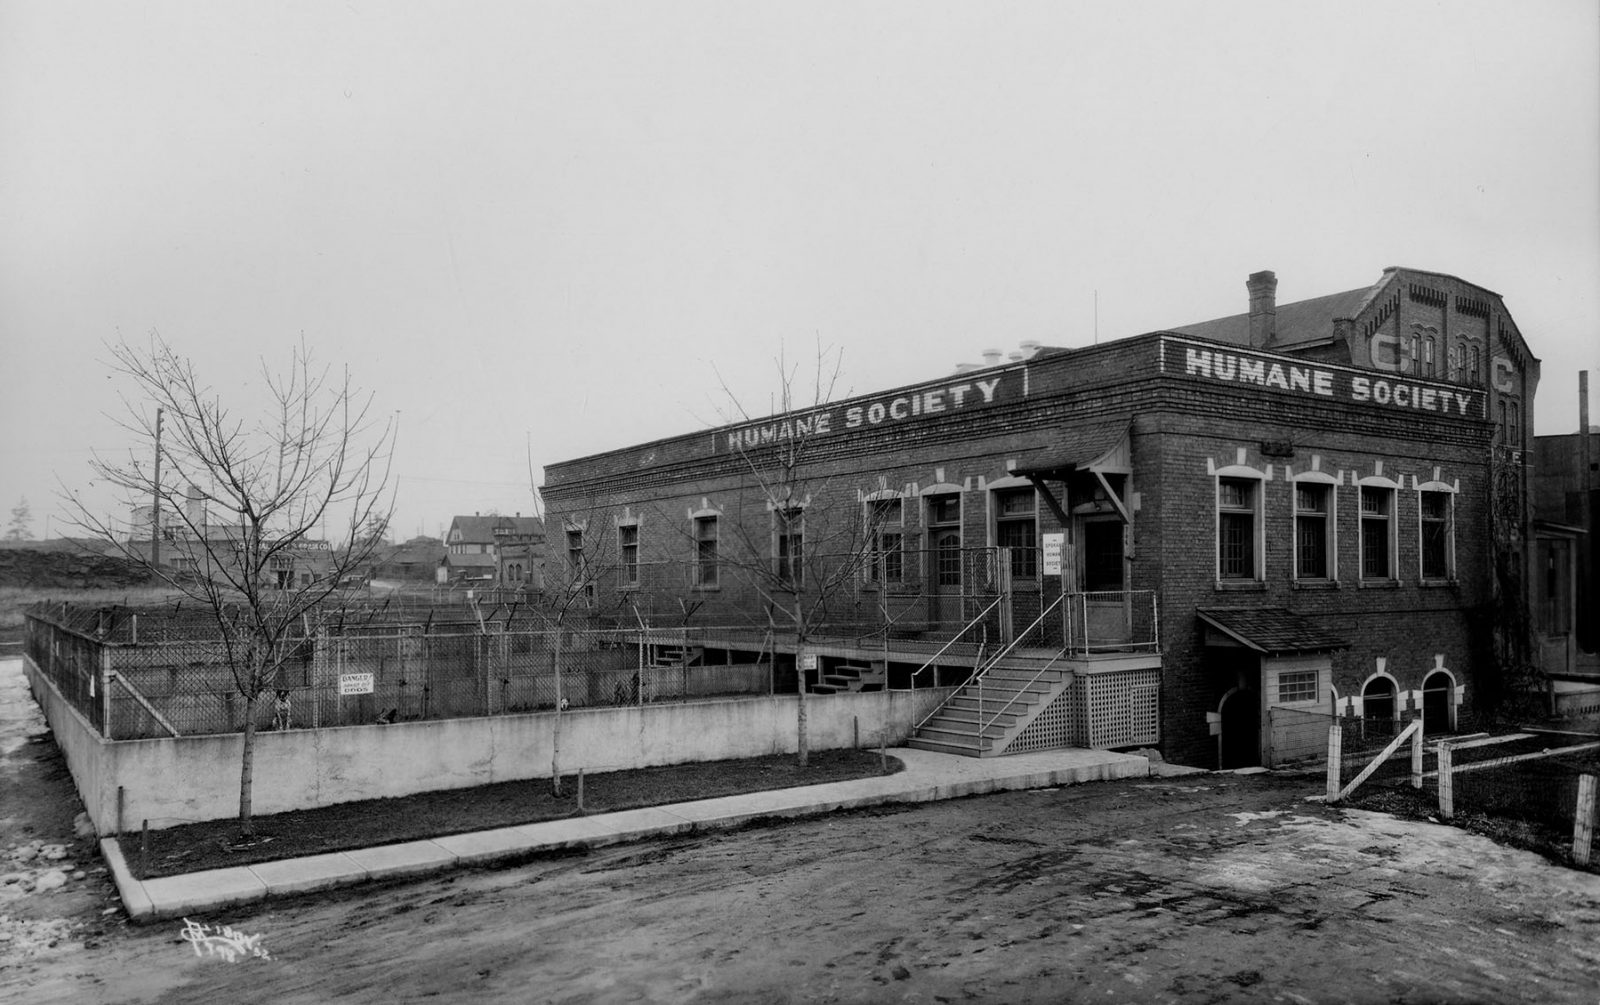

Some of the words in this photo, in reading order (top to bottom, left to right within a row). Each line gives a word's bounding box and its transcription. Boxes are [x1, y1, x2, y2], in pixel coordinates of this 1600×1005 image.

[1185, 348, 1334, 396] HUMANE
[1351, 376, 1472, 416] SOCIETY
[1490, 356, 1514, 393] C
[728, 413, 832, 450] HUMANE
[845, 378, 1001, 428] SOCIETY
